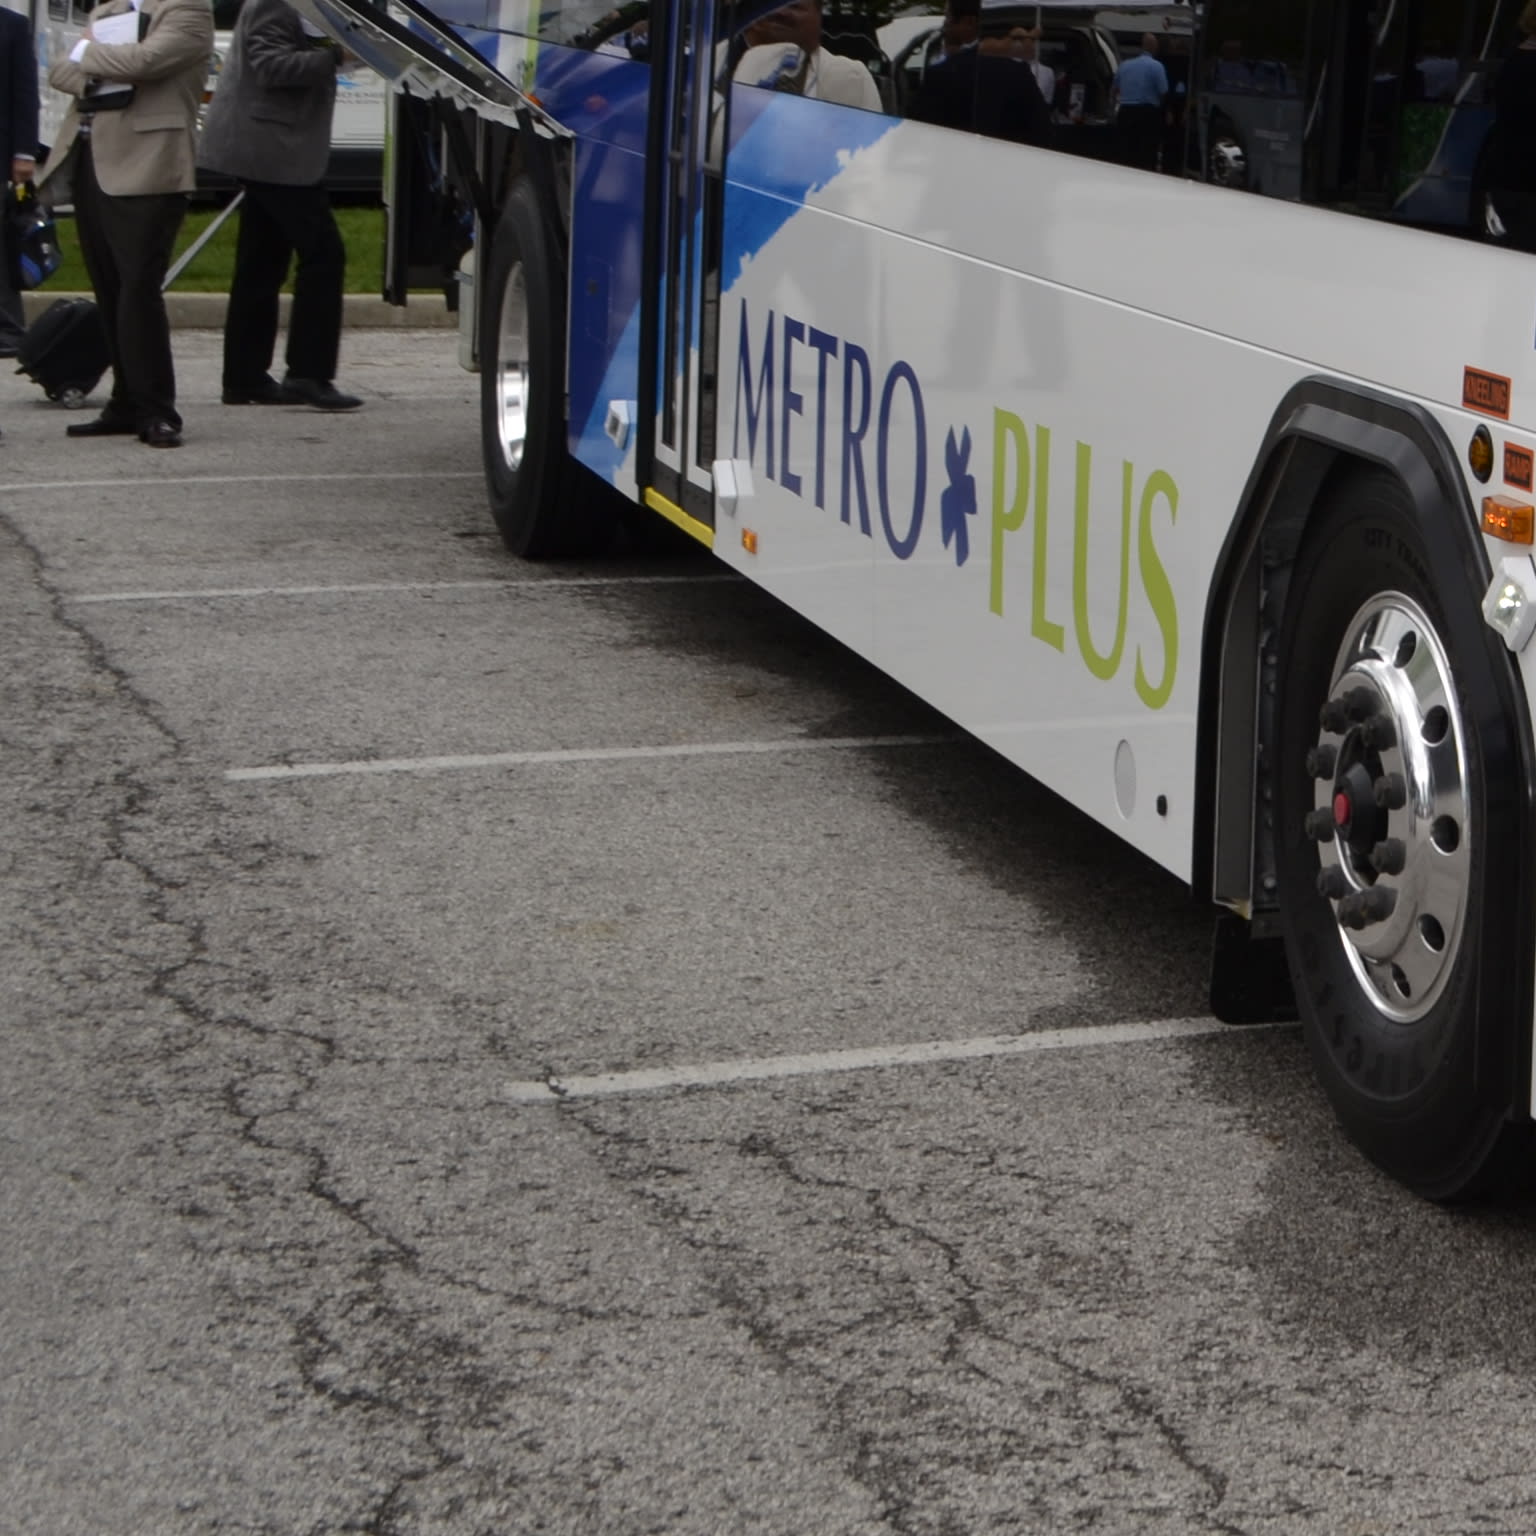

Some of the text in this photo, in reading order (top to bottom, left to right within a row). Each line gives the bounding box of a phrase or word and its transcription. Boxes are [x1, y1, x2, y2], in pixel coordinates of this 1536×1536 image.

[733, 296, 1180, 711] METRO PLUS
[1505, 452, 1530, 483] RAMP
